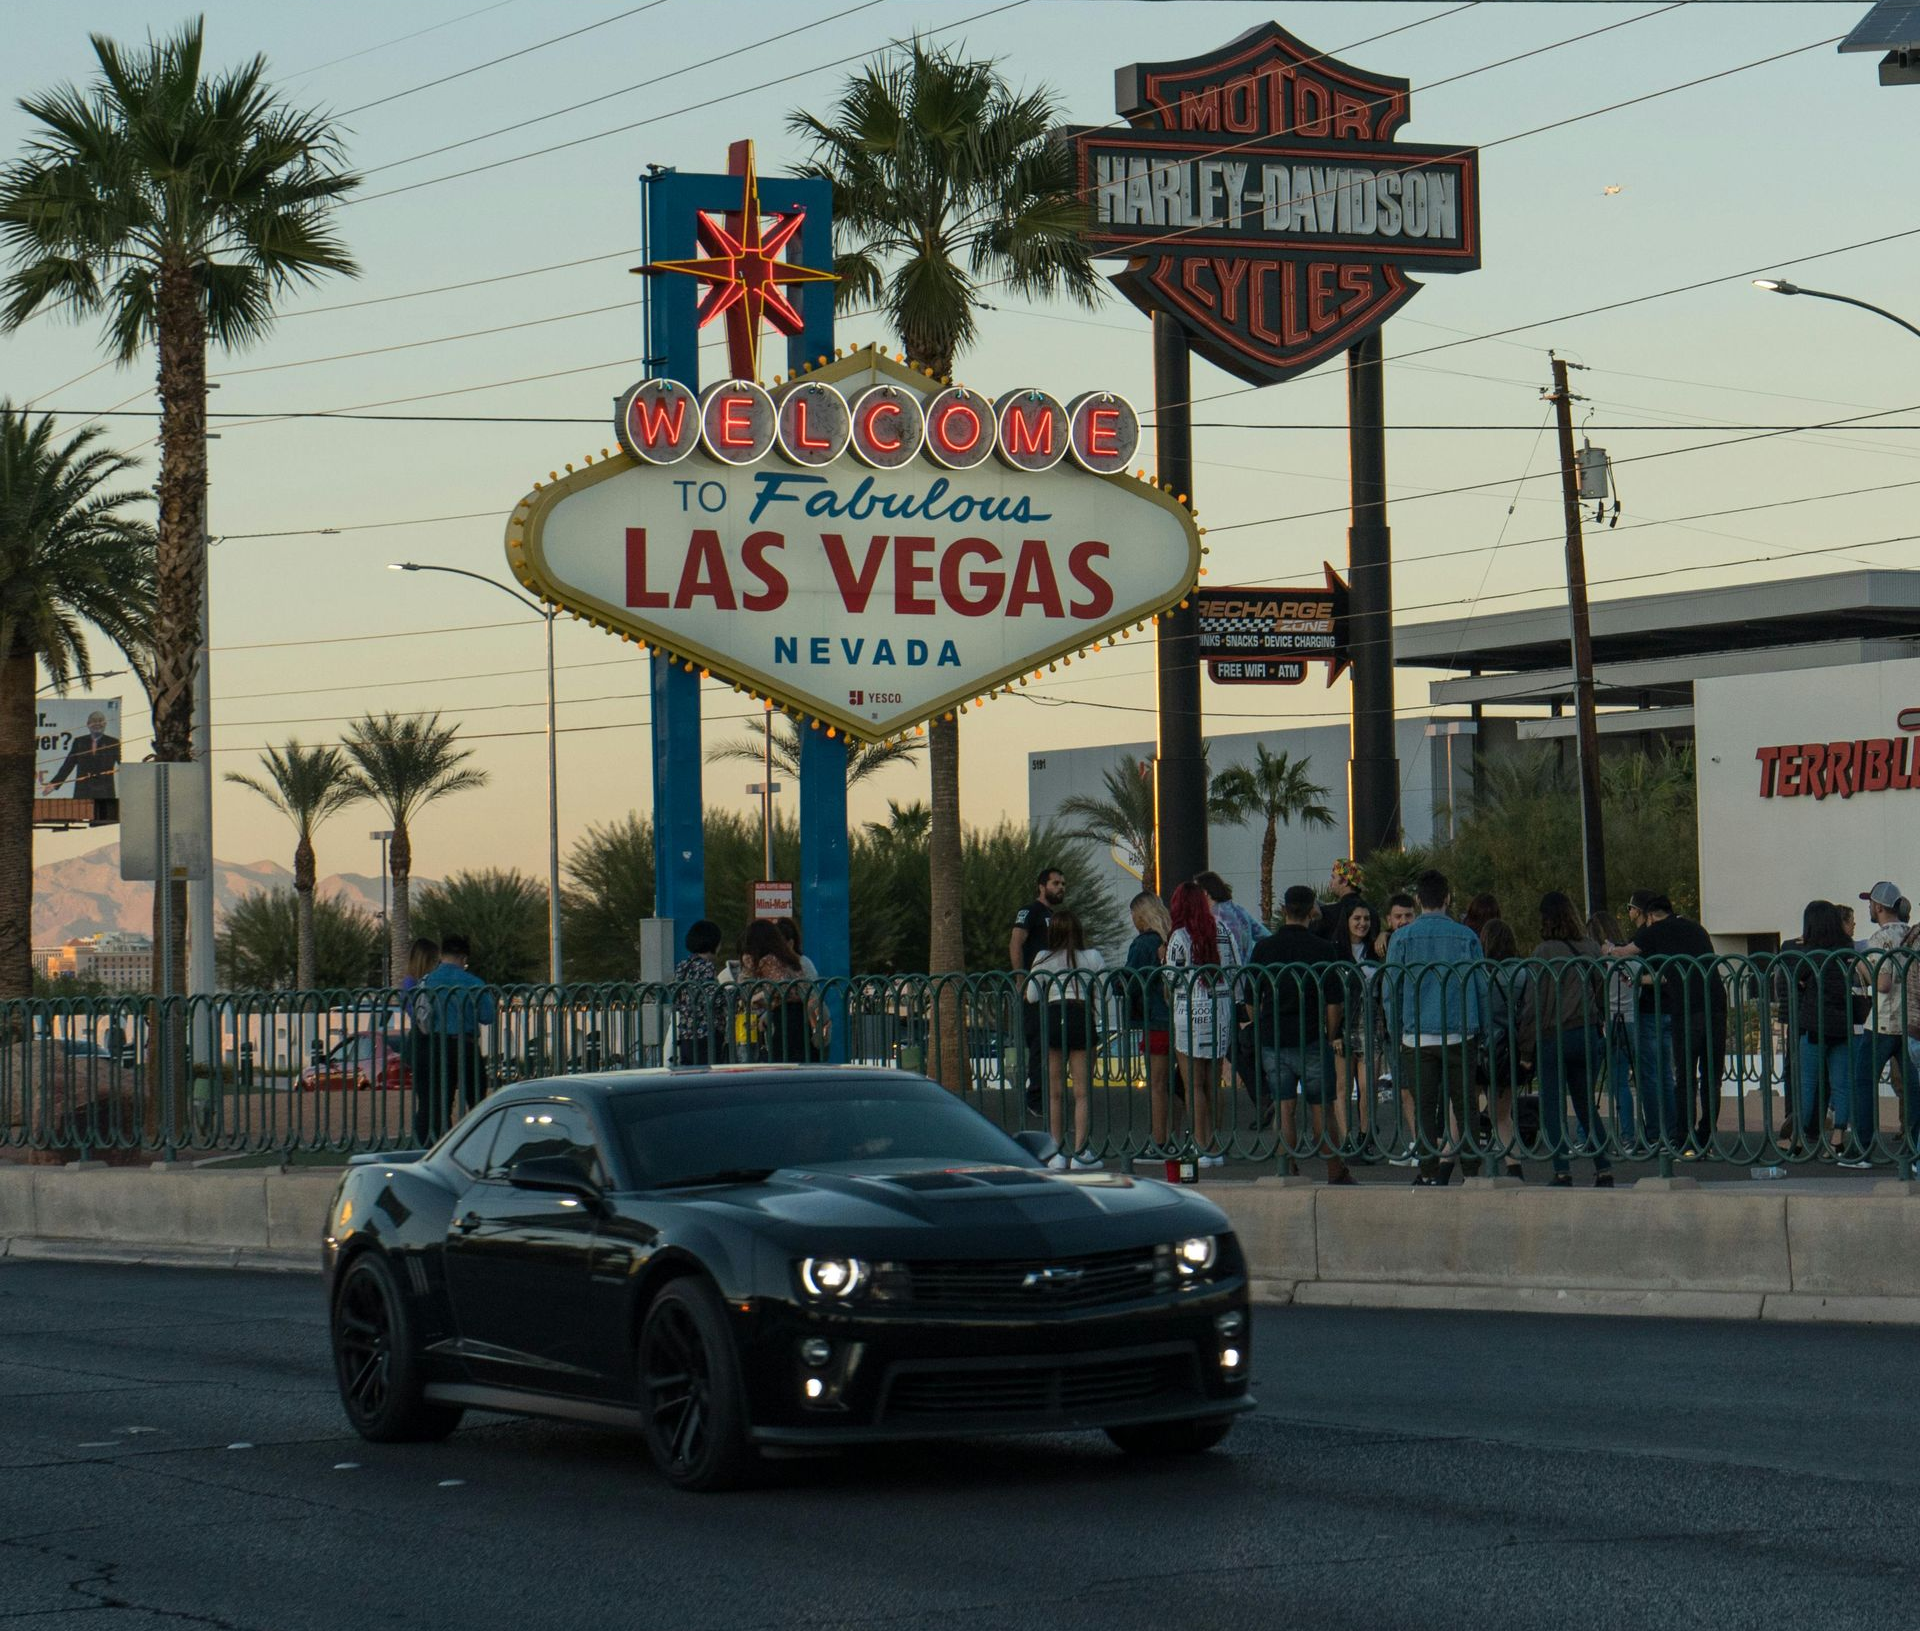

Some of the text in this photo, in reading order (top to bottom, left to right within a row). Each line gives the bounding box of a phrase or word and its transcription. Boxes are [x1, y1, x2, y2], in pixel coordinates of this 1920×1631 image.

[1180, 57, 1374, 141] MOTOR
[1097, 155, 1457, 239] HARLEY-DAVIDSON
[1181, 256, 1374, 347] CYCLES
[637, 398, 1120, 457] WELCOME
[673, 472, 1052, 524] TO Fabulous
[625, 527, 1115, 620] LAS VEGAS
[774, 636, 962, 667] NEVADA
[1200, 634, 1336, 648] INKS SNACKS DEVICE CHARGING
[1280, 620, 1329, 632] ZONE
[1218, 663, 1299, 678] FREE WIFI ATM
[868, 692, 902, 704] YESCO
